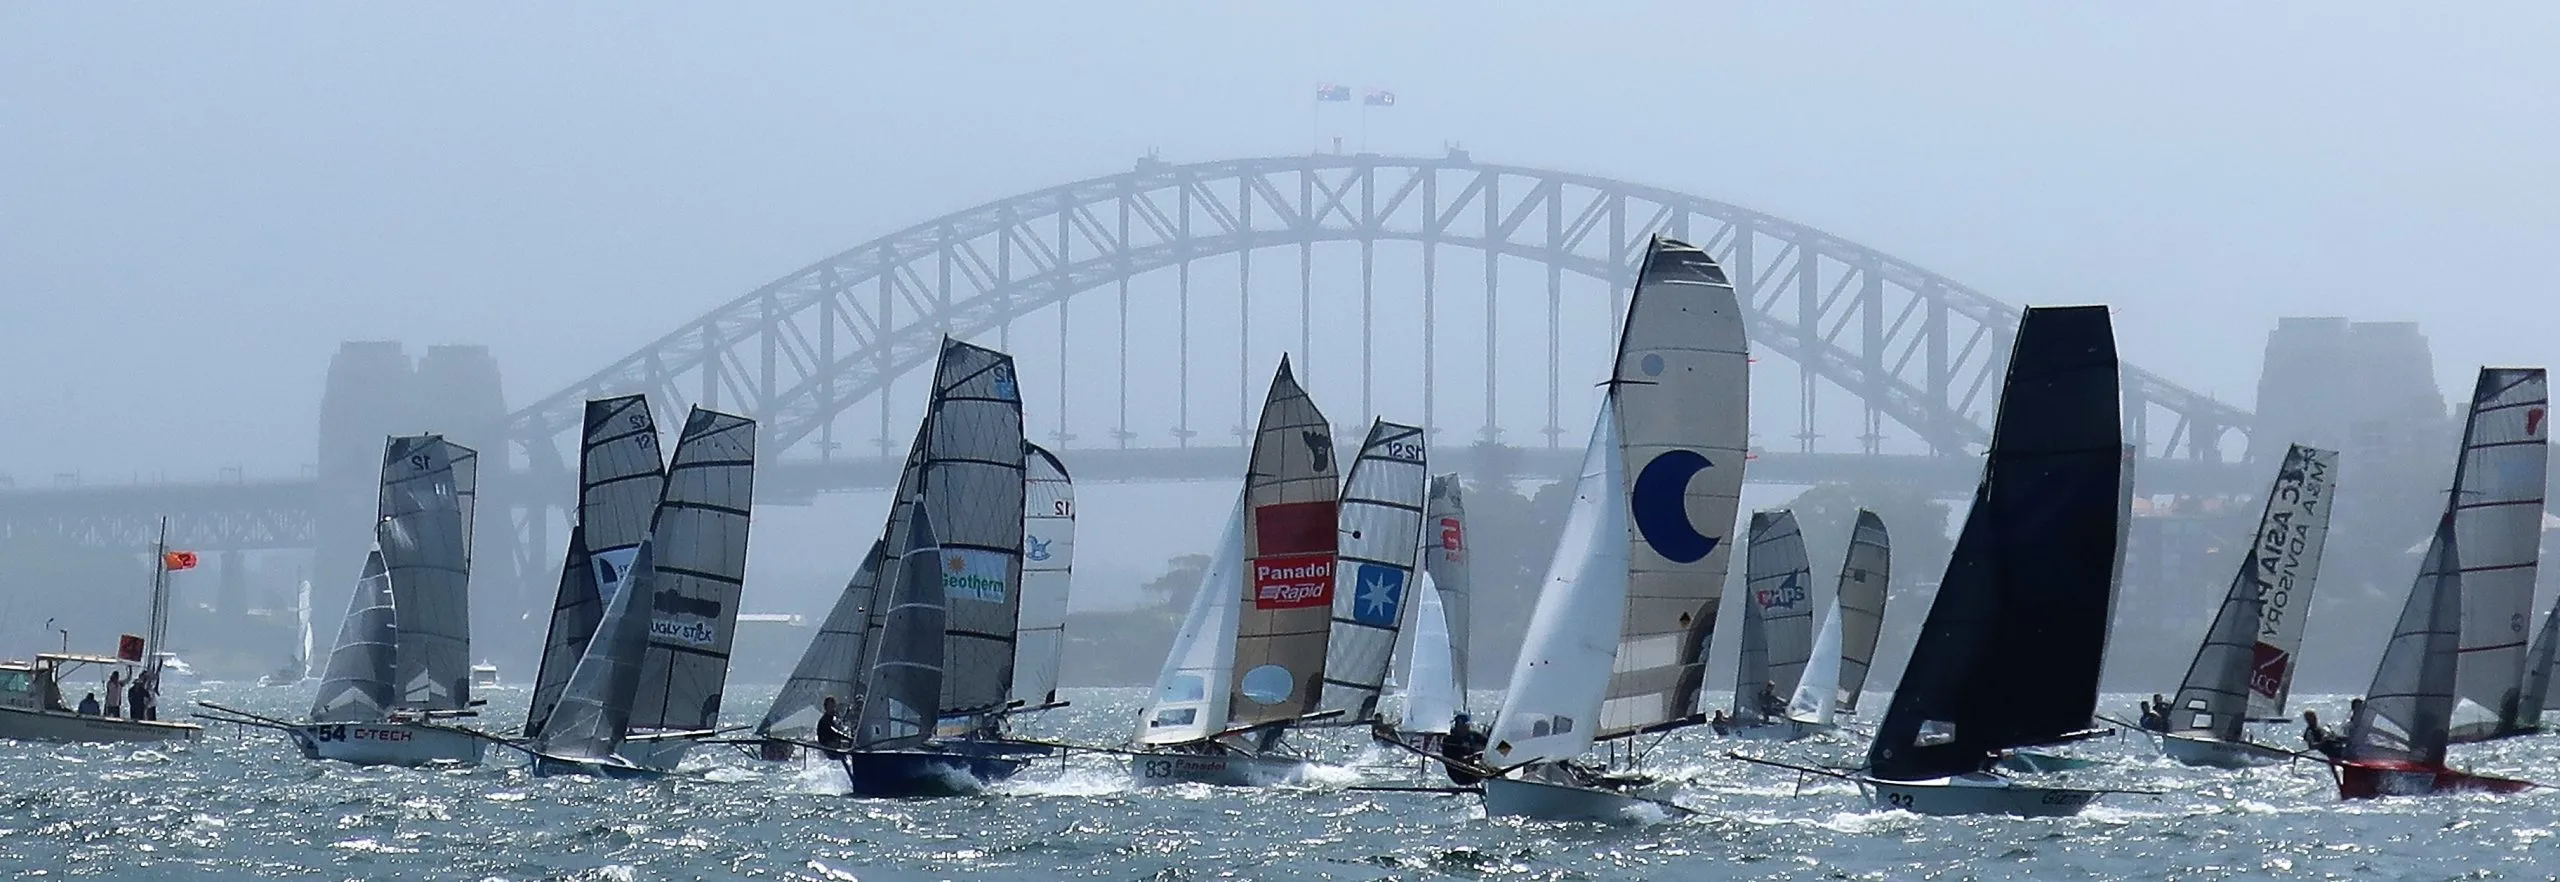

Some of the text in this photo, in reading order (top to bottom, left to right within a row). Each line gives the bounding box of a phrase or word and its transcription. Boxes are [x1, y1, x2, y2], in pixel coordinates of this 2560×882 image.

[1258, 562, 1331, 581] Panadol
[1274, 582, 1326, 602] Rapid
[650, 620, 682, 636] UGLY
[319, 725, 413, 742] 54 C-TECH
[1145, 760, 1172, 779] 83
[1175, 759, 1228, 771] Panadol
